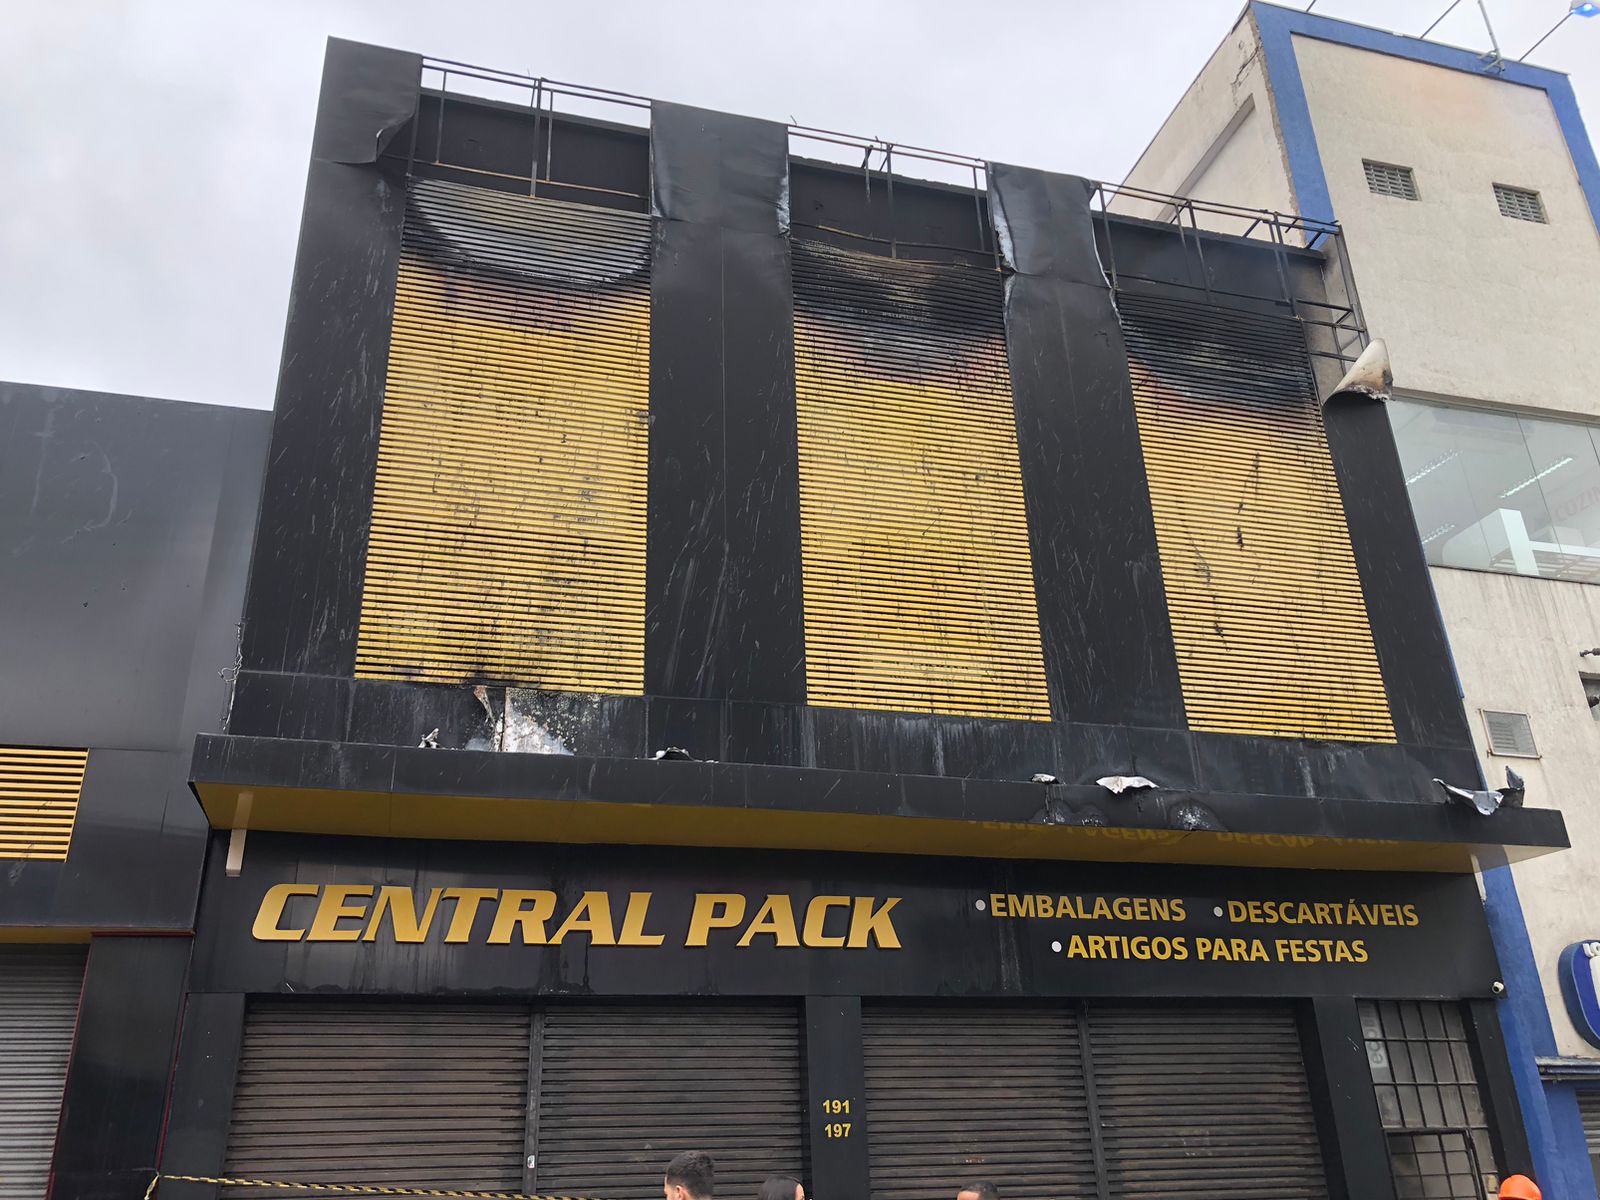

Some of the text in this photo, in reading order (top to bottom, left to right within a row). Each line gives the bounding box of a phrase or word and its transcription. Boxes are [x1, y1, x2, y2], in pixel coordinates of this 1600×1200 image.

[252, 883, 902, 949] CENTRAL PACK
[990, 893, 1419, 927] EMBALAGENS DESCARTÁVEIS
[1067, 934, 1369, 963] ARTIGOS PARA FESTAS
[822, 1099, 850, 1114] 191
[825, 1123, 851, 1138] 197
